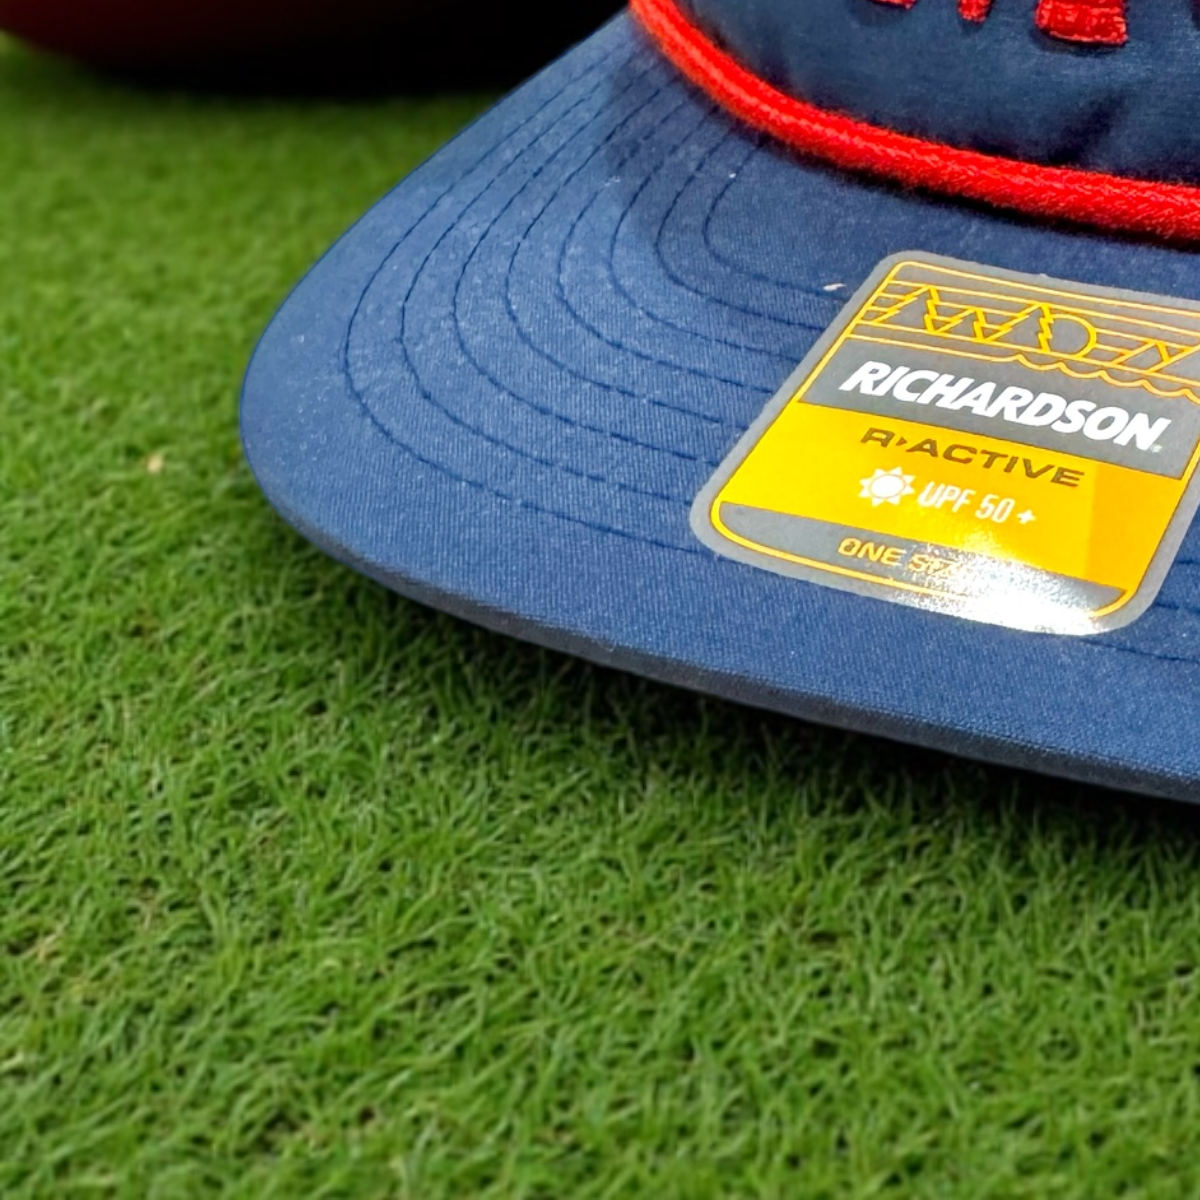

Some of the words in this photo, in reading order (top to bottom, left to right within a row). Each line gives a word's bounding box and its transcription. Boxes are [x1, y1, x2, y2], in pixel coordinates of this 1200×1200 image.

[839, 360, 1171, 452] RICHARDSON
[917, 480, 976, 513] UPF
[838, 537, 906, 566] ONE
